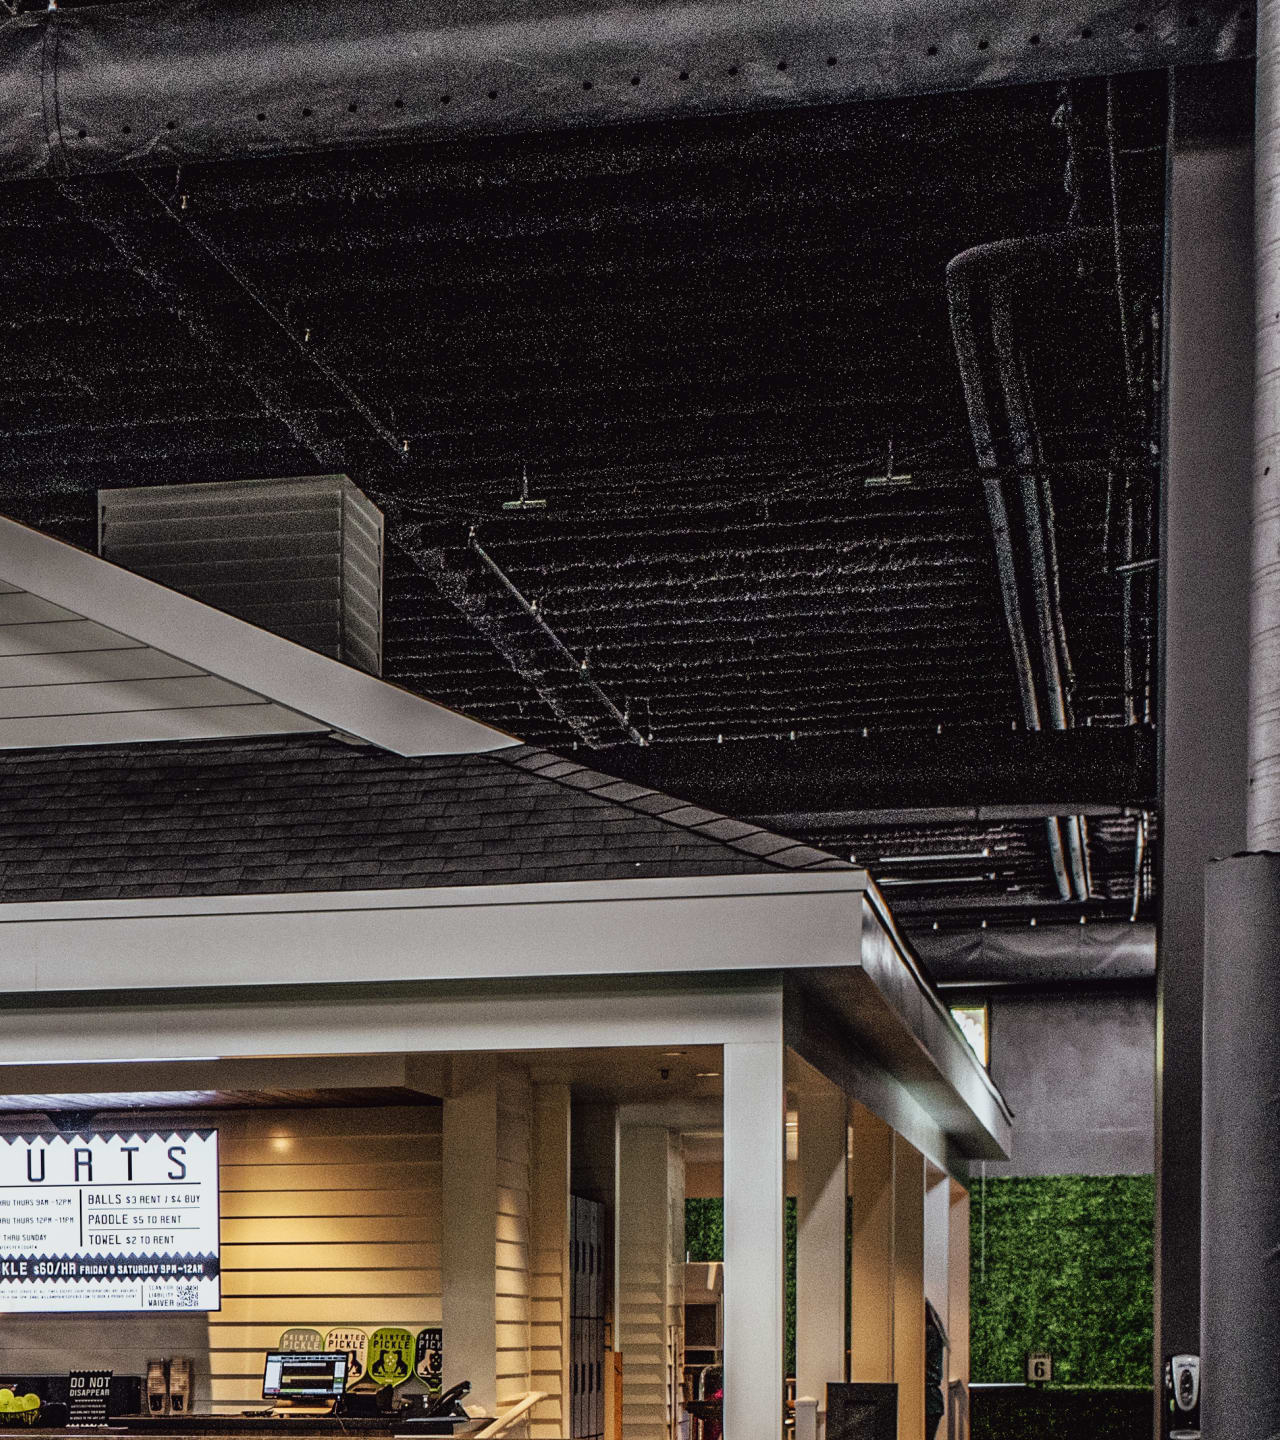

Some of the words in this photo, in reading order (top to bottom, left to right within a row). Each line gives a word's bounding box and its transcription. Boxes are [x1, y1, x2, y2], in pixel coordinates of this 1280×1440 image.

[88, 1194, 121, 1204] BALLS
[140, 1195, 161, 1204] RENT
[185, 1195, 200, 1203] BUY
[88, 1214, 128, 1224] PADDLE
[161, 1215, 182, 1223] RENT
[89, 1235, 121, 1245] TOWEL
[141, 1236, 150, 1244] TO
[154, 1236, 174, 1244] RENT
[80, 1265, 108, 1274] FRIDAY
[117, 1264, 158, 1274] SATURDAY
[148, 1299, 174, 1307] WAIVER
[284, 1341, 319, 1351] PICKLE
[328, 1341, 364, 1349] PICKLE
[374, 1341, 410, 1349] PICKLE
[1034, 1361, 1045, 1378] 6
[70, 1378, 84, 1388] DO
[90, 1377, 110, 1388] NOT
